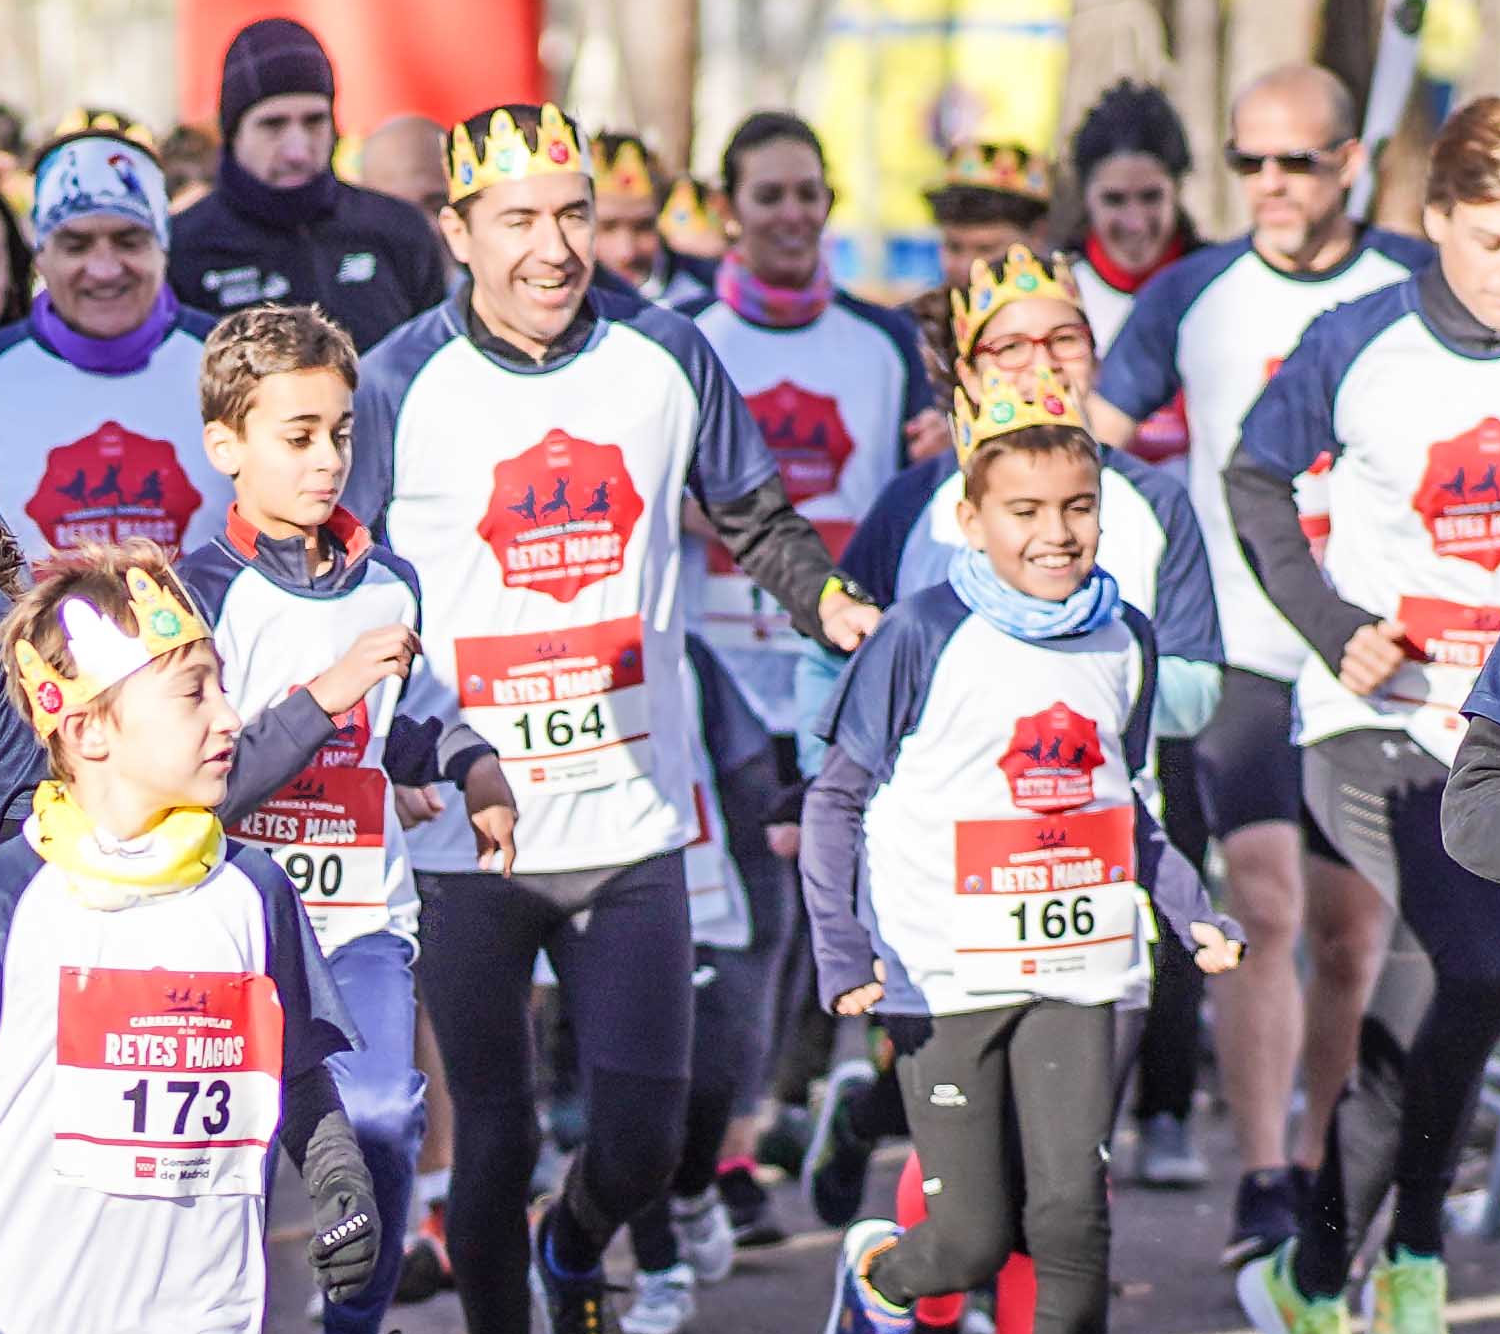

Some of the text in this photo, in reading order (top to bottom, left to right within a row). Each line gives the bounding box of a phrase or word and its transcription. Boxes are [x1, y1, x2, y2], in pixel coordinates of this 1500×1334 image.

[513, 702, 606, 750] 164
[240, 811, 357, 844] REYES MAGOS
[264, 848, 343, 897] 90
[1009, 894, 1095, 941] 166
[129, 1014, 233, 1029] CARRERA POPULAR
[104, 1033, 245, 1069] REYES MAGOS
[122, 1079, 231, 1135] 173
[160, 1156, 212, 1167] Comunidad
[160, 1169, 210, 1180] de Madrid
